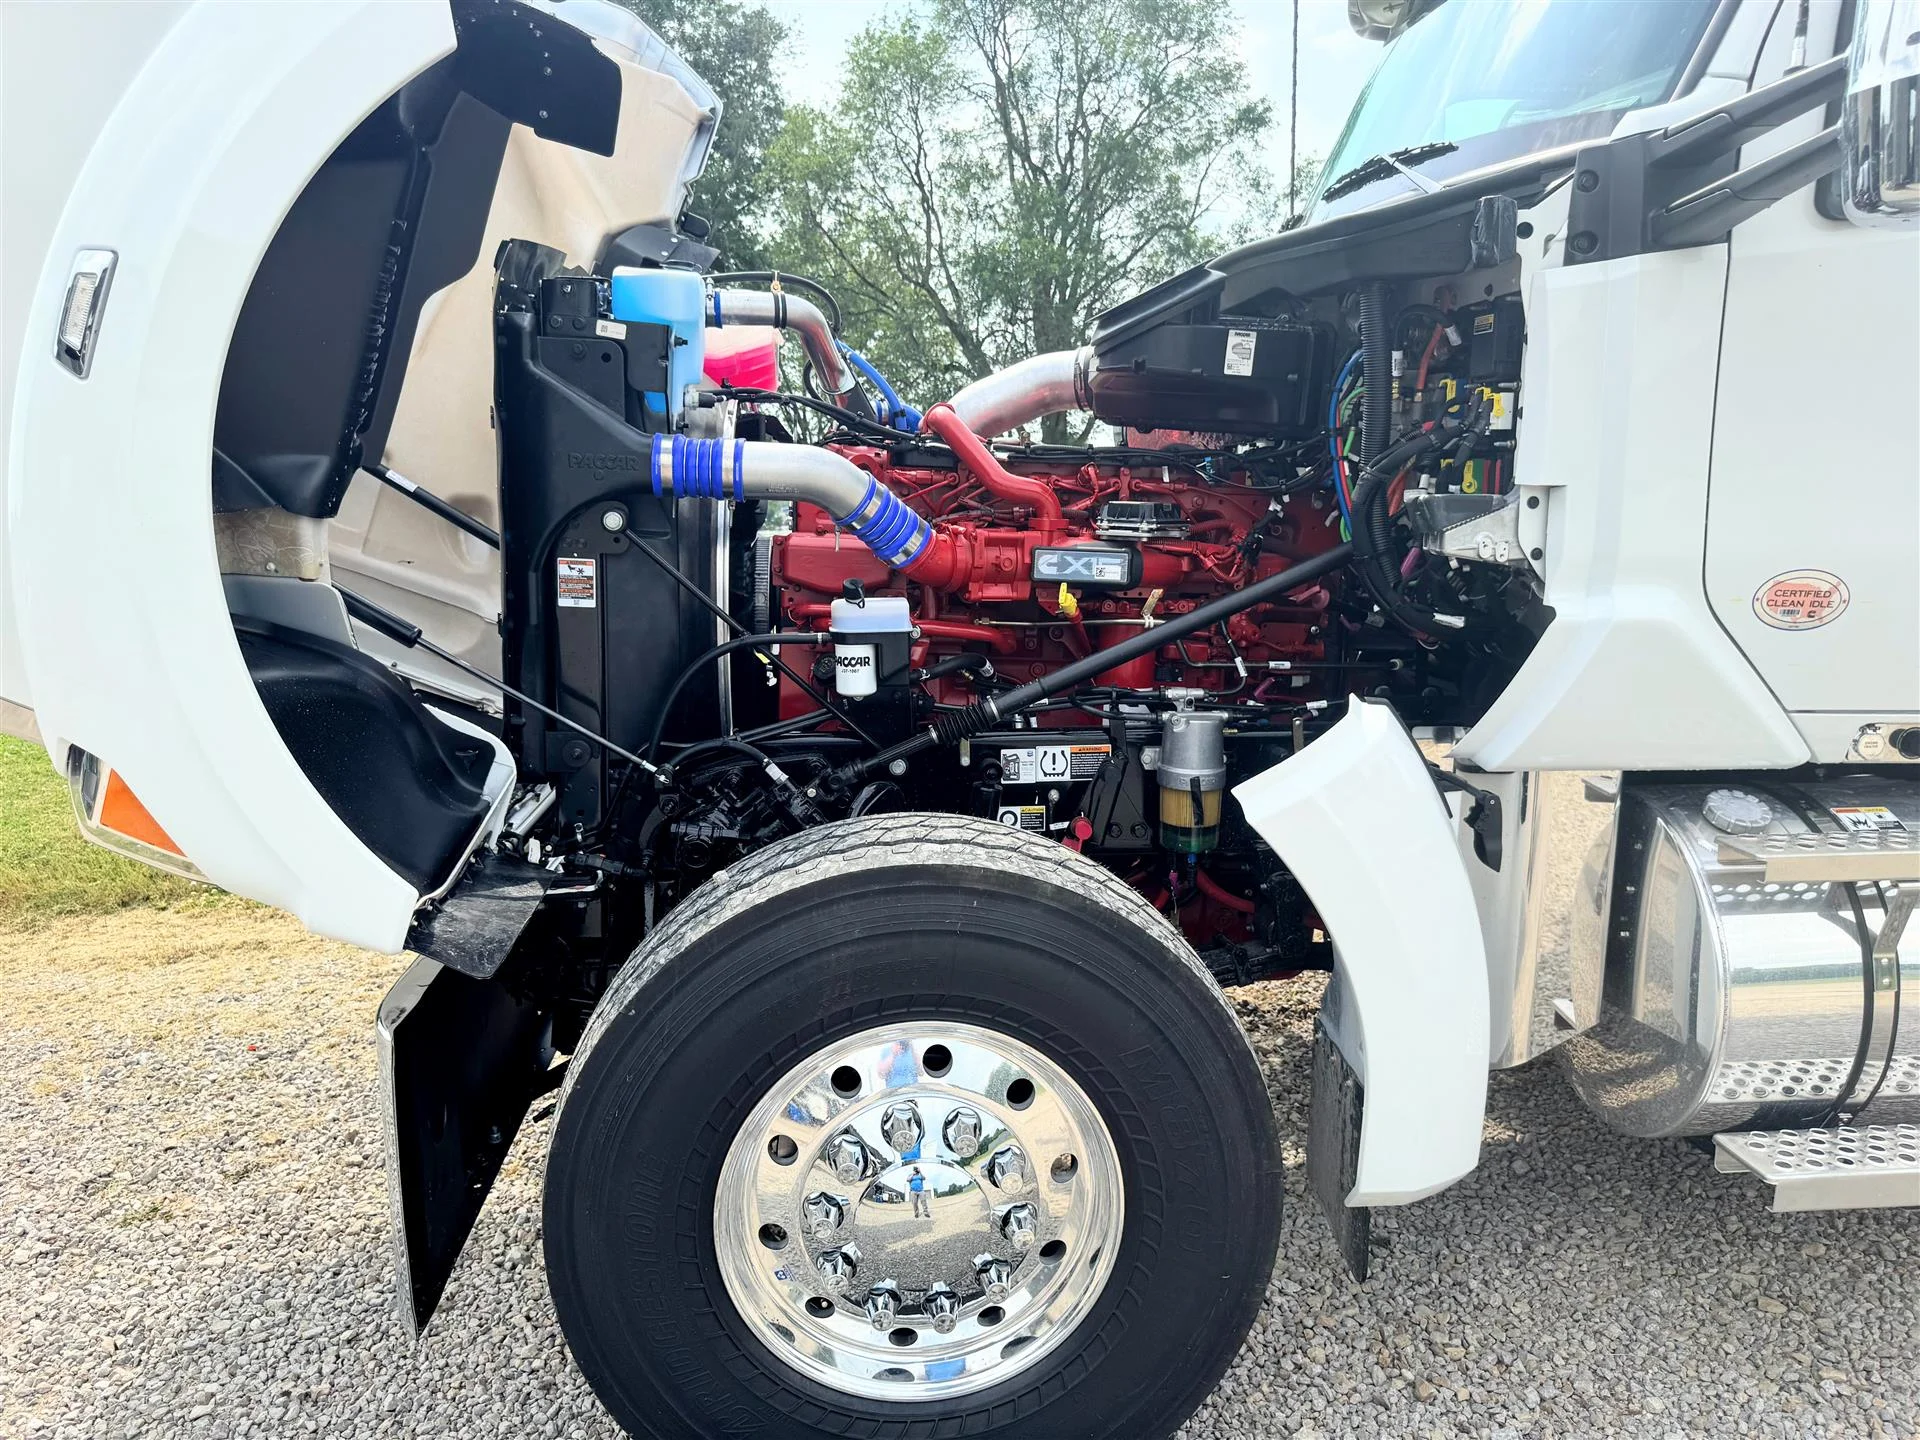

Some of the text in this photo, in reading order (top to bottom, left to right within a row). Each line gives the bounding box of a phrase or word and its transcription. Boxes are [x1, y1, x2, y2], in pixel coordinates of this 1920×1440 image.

[567, 452, 640, 471] PACCAR
[1774, 589, 1832, 599] CERTIFIED
[1766, 599, 1835, 609] CLEAN IDLE
[835, 656, 871, 668] ACCAR
[623, 1146, 768, 1437] BRIDGESTONE
